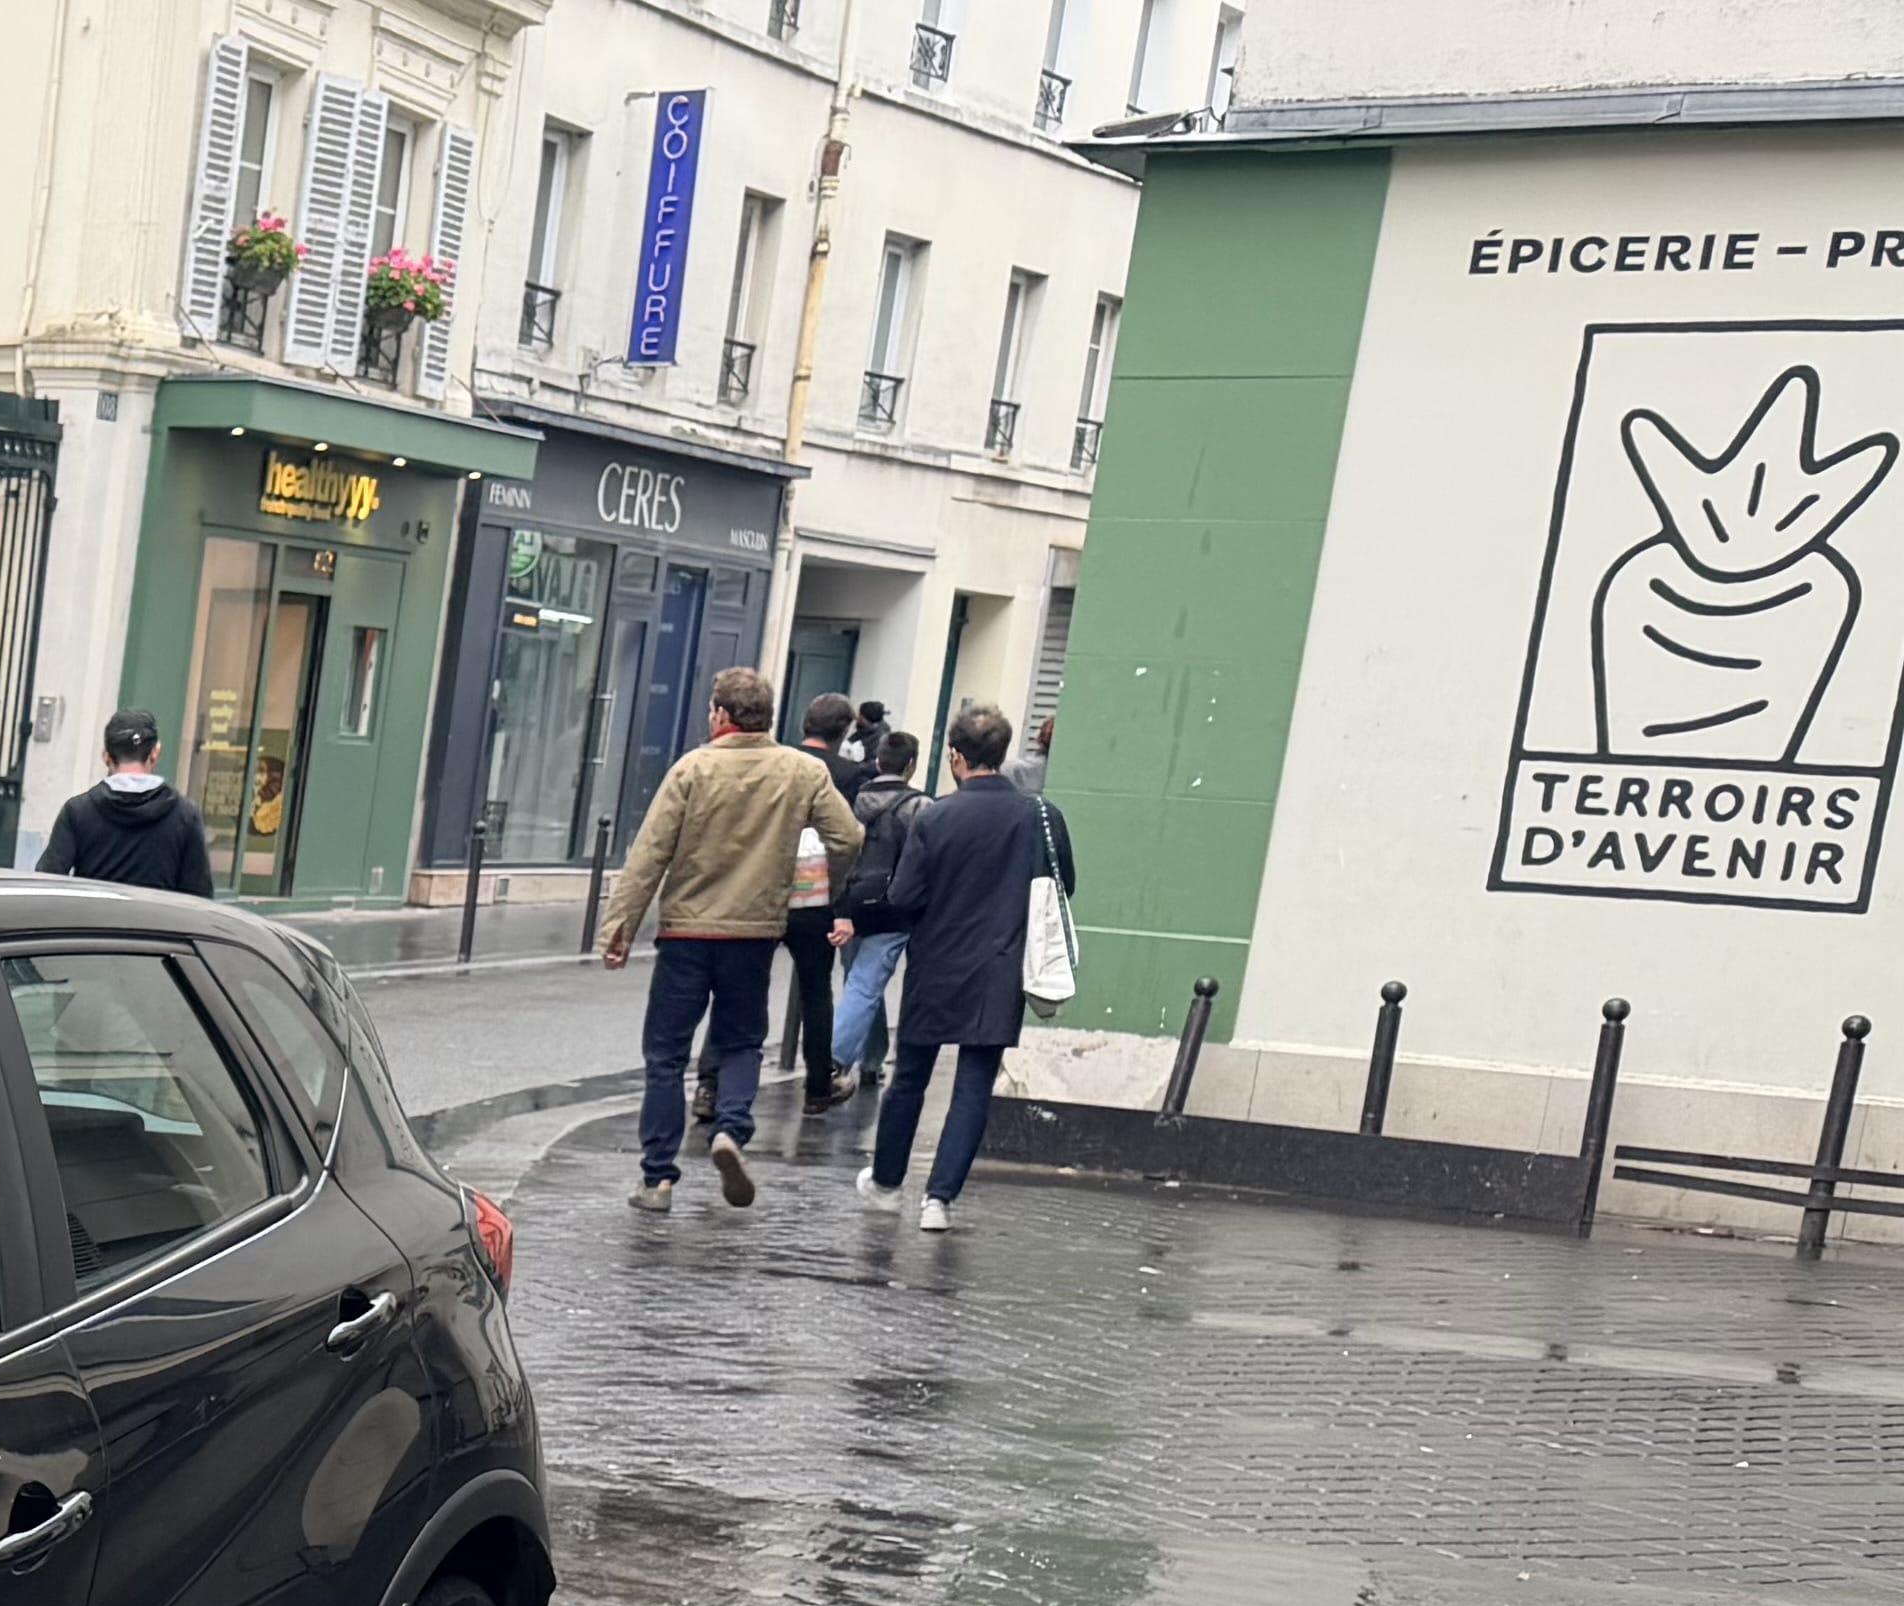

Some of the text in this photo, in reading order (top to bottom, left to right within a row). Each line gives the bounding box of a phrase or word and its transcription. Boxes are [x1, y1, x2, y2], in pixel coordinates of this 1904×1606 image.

[640, 95, 689, 356] COIFFURE
[1469, 229, 1760, 276] ÉPICERIE
[597, 461, 686, 535] CERES
[1532, 772, 1861, 832] TERROIRS
[1520, 827, 1845, 886] D'AVENIR
